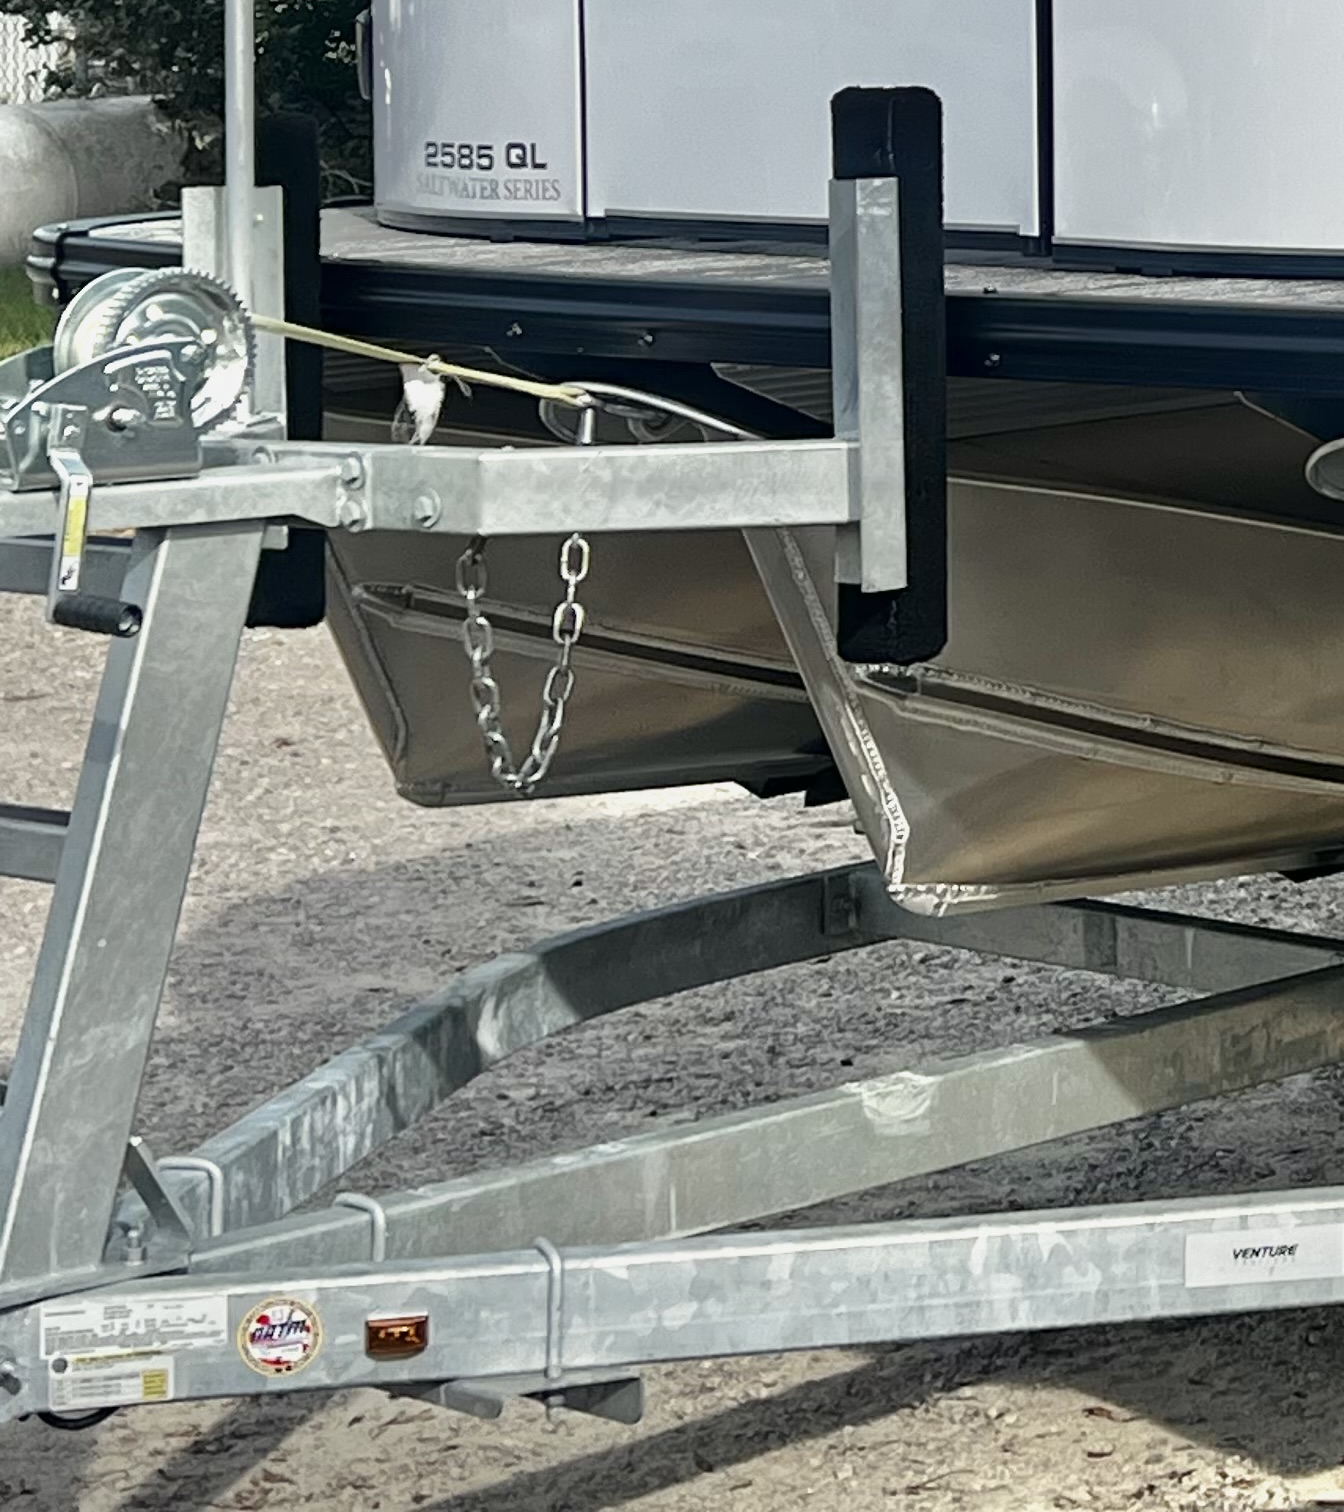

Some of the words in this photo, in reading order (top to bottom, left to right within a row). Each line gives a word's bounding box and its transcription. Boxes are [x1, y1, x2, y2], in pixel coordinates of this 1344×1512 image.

[425, 141, 495, 170] 2585
[504, 141, 549, 171] QL
[416, 173, 501, 200] SALTWATER
[502, 177, 562, 202] SERIES
[1232, 1243, 1299, 1260] VENTURE
